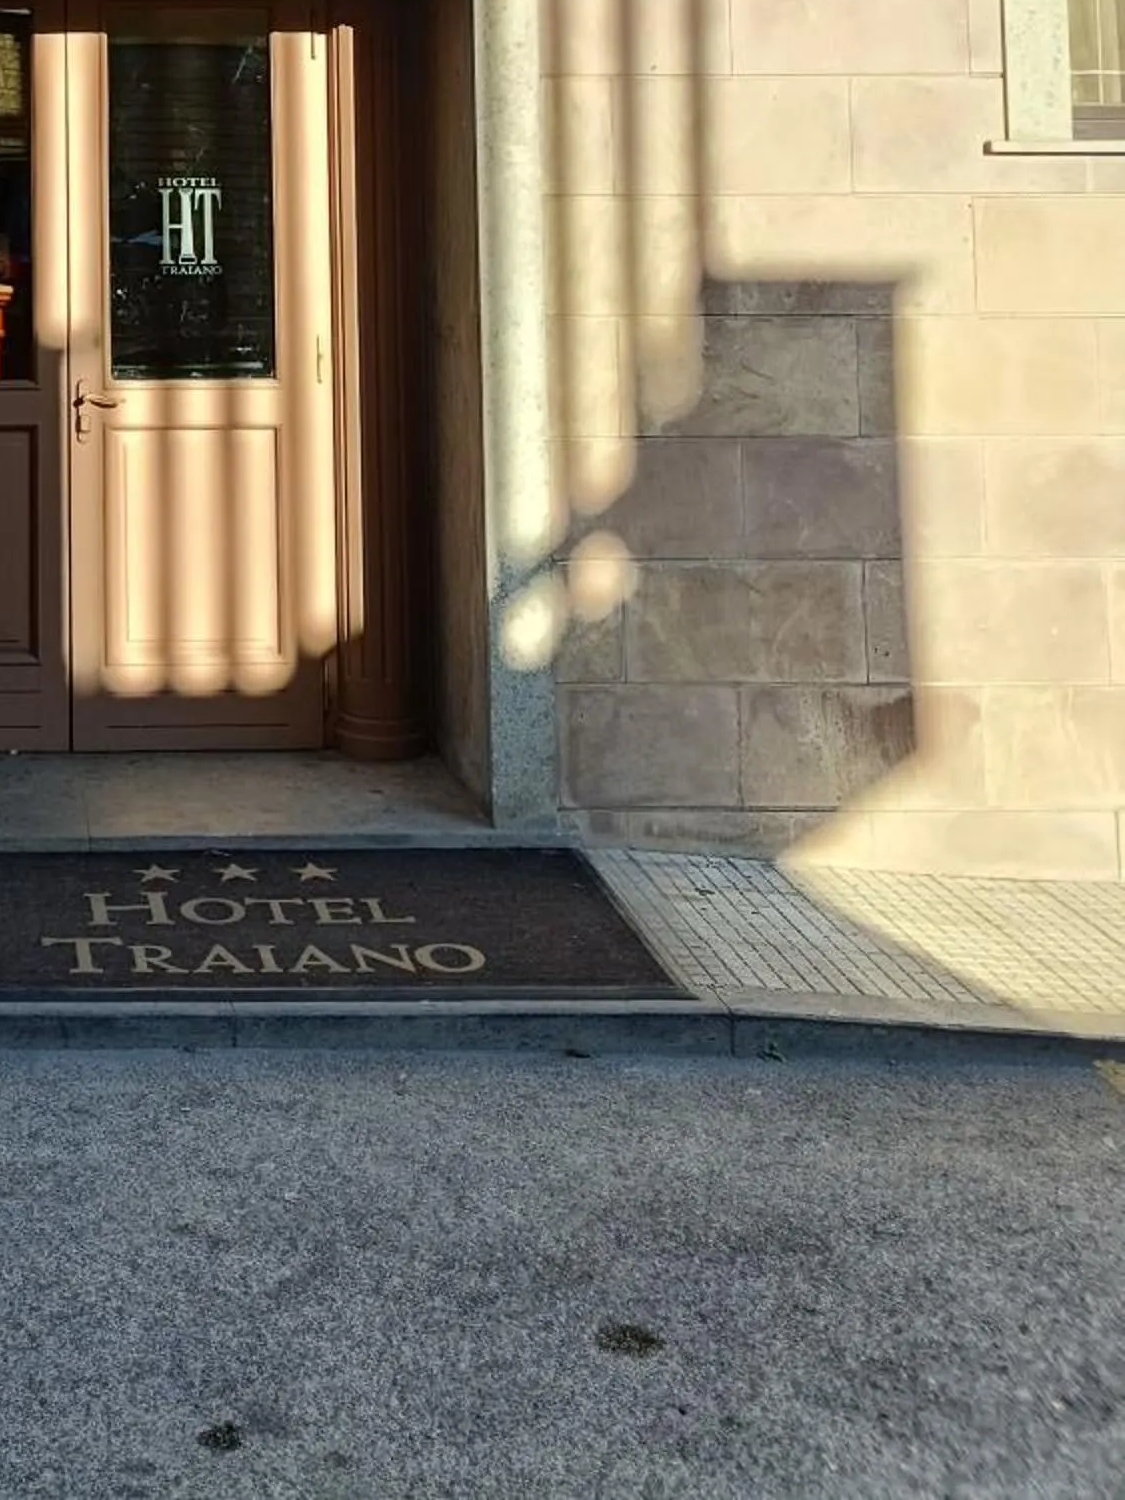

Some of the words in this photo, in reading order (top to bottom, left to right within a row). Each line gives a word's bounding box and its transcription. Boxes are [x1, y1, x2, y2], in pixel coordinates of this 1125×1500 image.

[158, 177, 220, 187] HOTEL
[158, 188, 222, 265] HT
[162, 265, 223, 275] TRAIANO
[85, 891, 417, 927] HOTEL
[41, 936, 487, 974] TRAIANO
